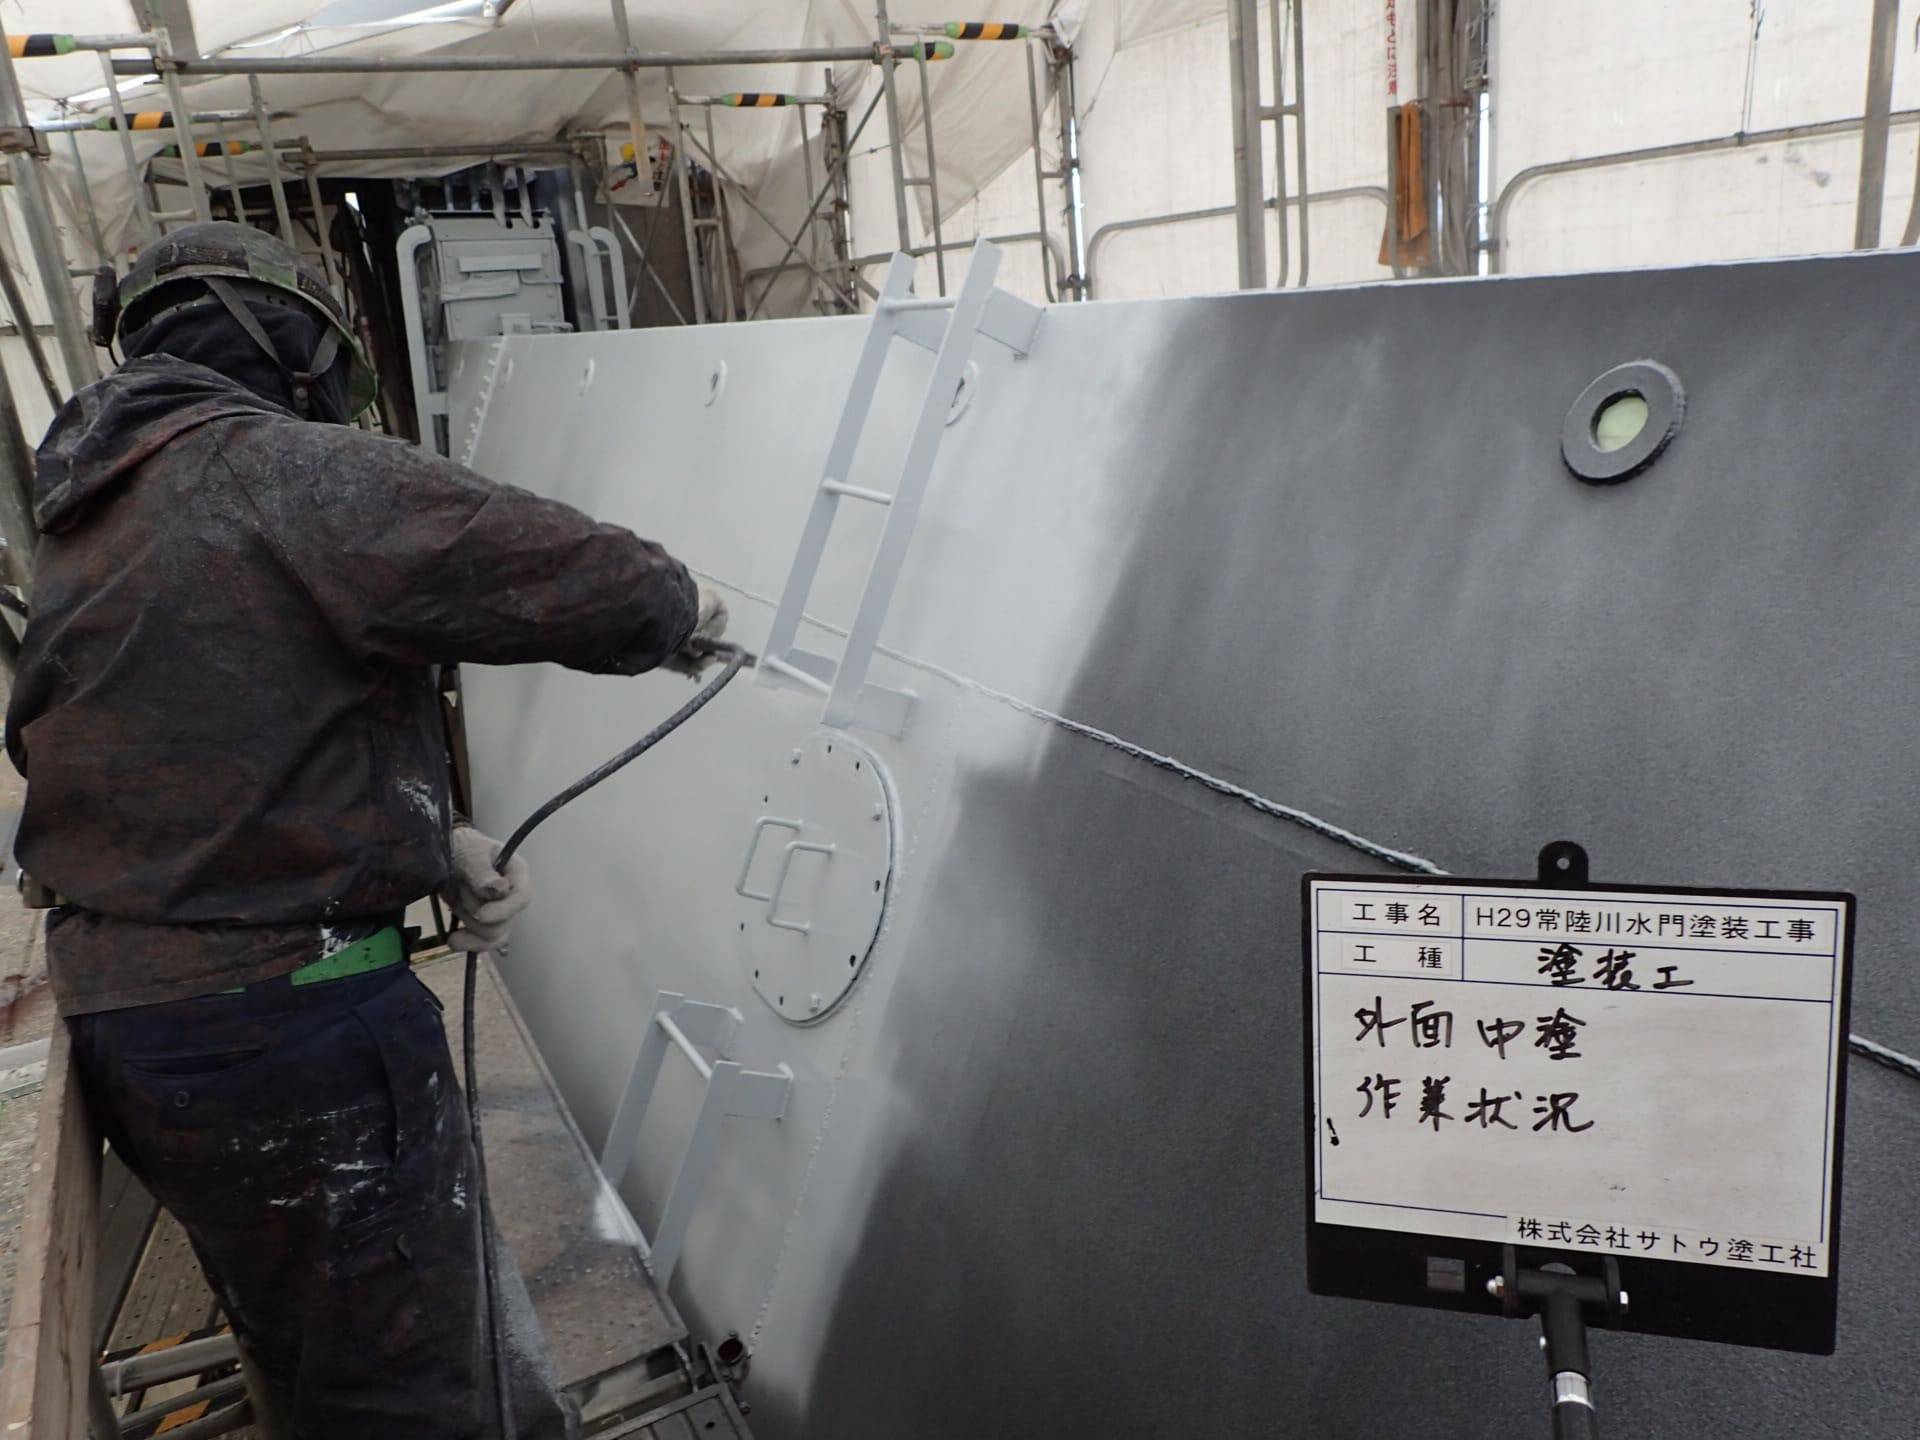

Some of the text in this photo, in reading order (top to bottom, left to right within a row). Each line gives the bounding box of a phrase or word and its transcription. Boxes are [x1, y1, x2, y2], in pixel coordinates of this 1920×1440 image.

[1352, 902, 1441, 927] 工事名
[1475, 906, 1816, 943] H29常陸川水門塗装工事
[1353, 944, 1443, 969] 工種
[1537, 943, 1694, 991] 塗装工
[1356, 1073, 1594, 1132] 作業状況
[1517, 1216, 1818, 1269] 株式会社サトウ塗工社
